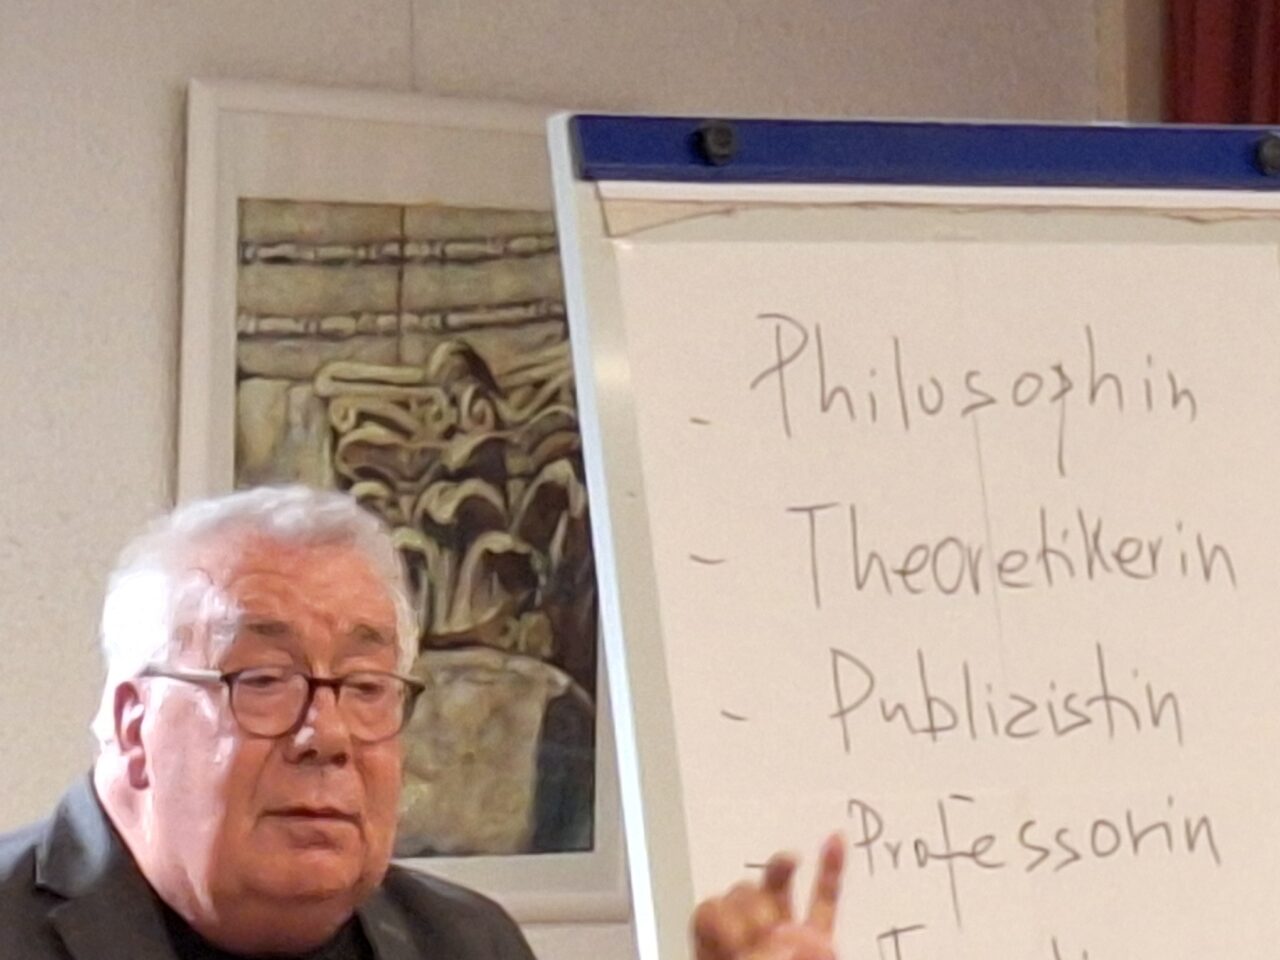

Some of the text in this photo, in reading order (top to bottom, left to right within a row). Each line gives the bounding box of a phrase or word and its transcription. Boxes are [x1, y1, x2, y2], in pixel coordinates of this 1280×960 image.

[750, 312, 1198, 477] Philosophin
[786, 502, 1237, 610] Theoretikerin
[829, 641, 1184, 754] Publizistin
[848, 794, 1222, 929] Professorin
